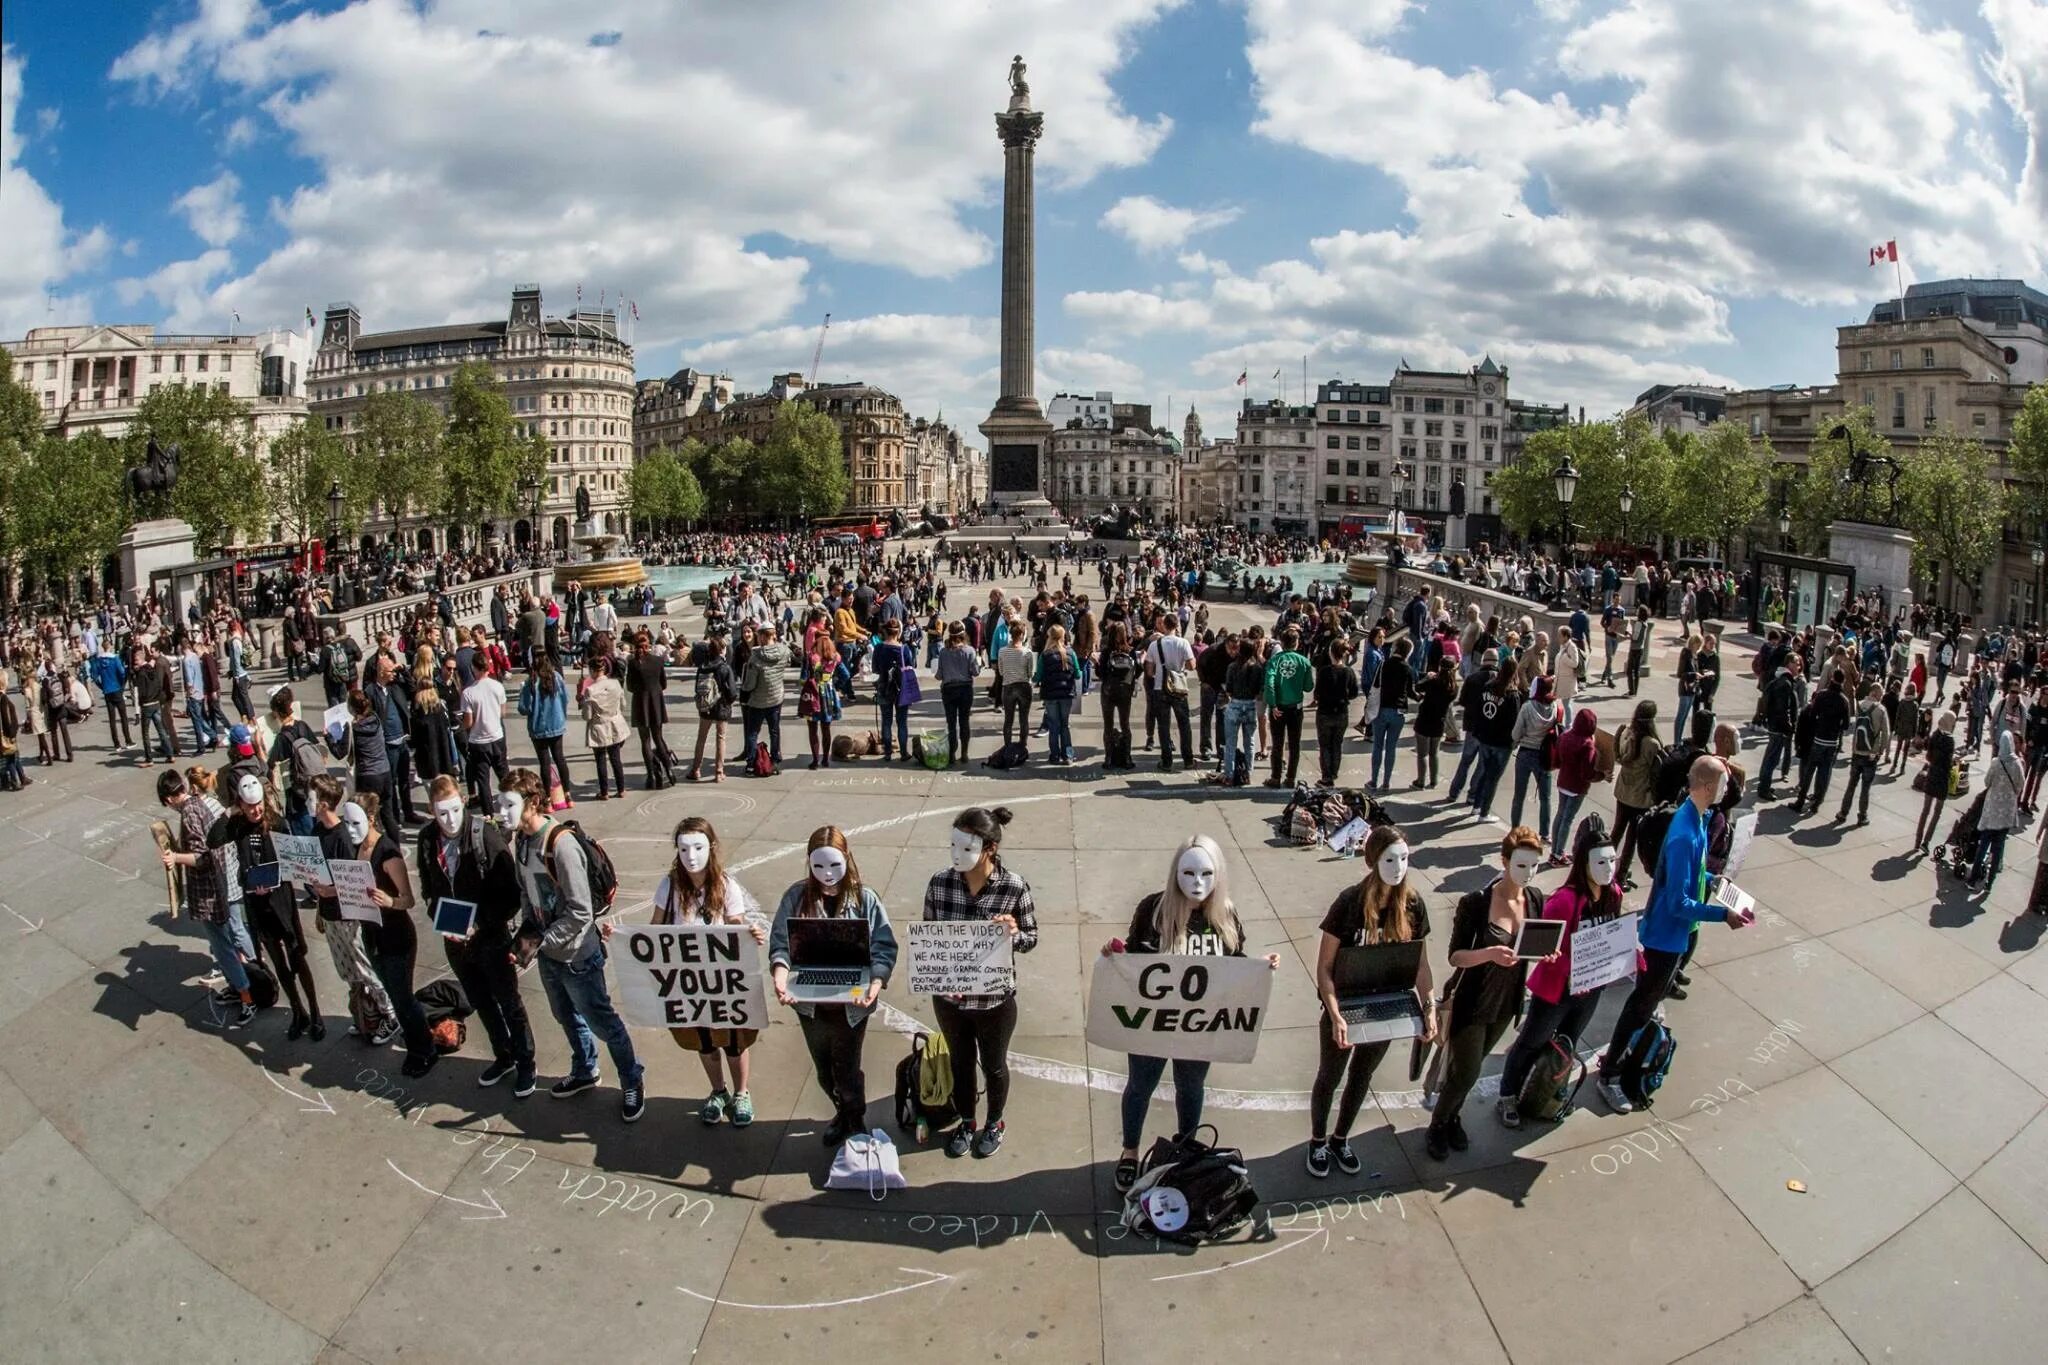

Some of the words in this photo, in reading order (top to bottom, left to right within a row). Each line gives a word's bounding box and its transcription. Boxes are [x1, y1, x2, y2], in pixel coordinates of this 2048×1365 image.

[910, 924, 944, 936] WATCH
[947, 924, 966, 936] THE
[970, 925, 1004, 936] VIDEO
[630, 932, 740, 963] OPEN
[914, 952, 927, 961] WE
[930, 952, 947, 961] ARE
[921, 940, 932, 949] TO
[952, 940, 968, 949] OUT
[973, 941, 995, 950] WHY
[649, 968, 749, 997] YOUR
[953, 965, 981, 973] GRAPHIC
[984, 966, 1012, 974] CONTENT
[1138, 962, 1209, 1001] GO
[665, 999, 749, 1025] EYES
[1111, 1004, 1260, 1032] VEGAN
[1689, 1077, 1761, 1117] the
[452, 1117, 537, 1185] the
[559, 1168, 715, 1227] watch
